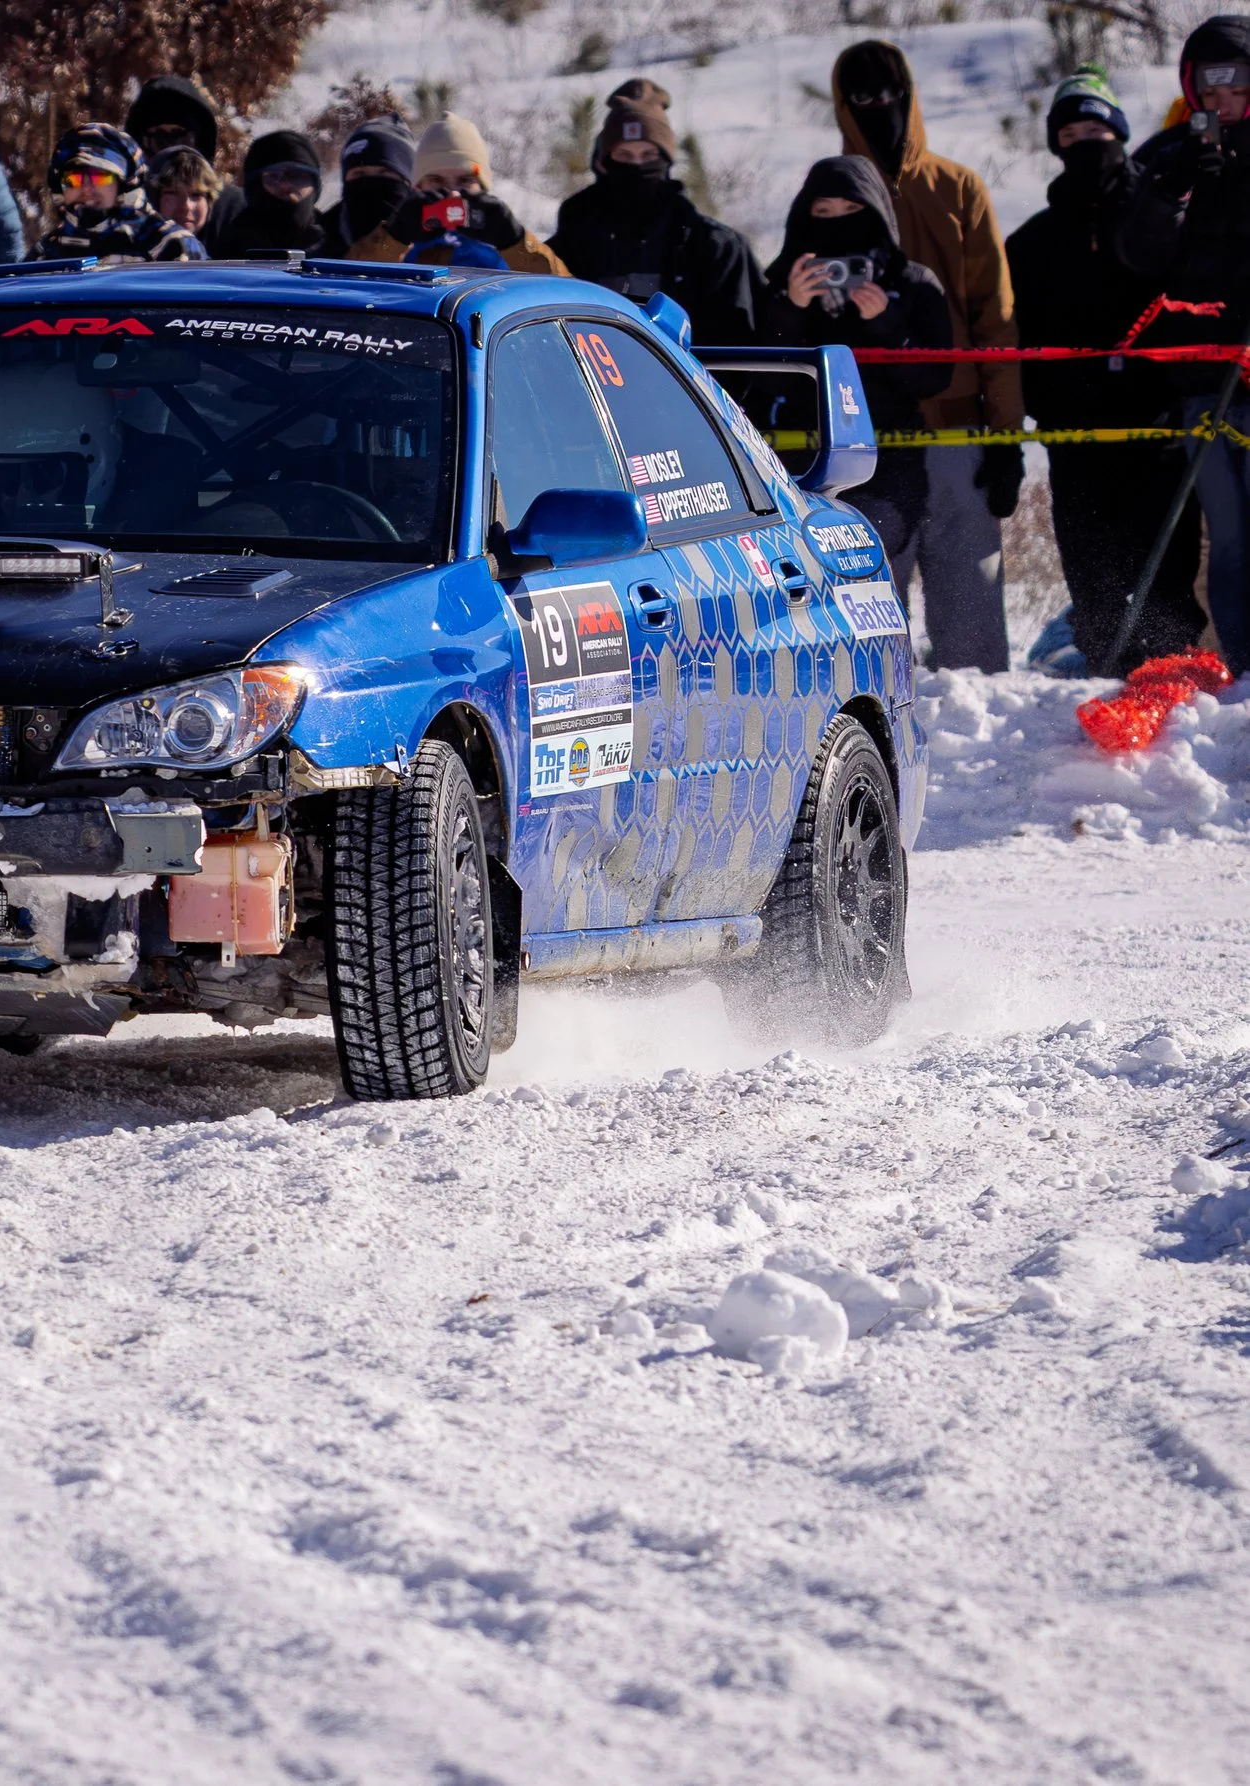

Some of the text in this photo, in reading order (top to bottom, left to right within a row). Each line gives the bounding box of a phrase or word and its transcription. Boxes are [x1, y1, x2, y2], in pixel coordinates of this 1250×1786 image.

[0, 317, 155, 337] ARA
[165, 318, 413, 351] AMERICAN RALLY
[180, 329, 381, 355] ASSOCIATION
[576, 333, 624, 387] 19
[643, 450, 685, 484] MOSLEY
[657, 482, 732, 522] OPPERTHAUSER
[807, 523, 876, 553] SPRINGLINE
[837, 553, 874, 571] EXCAVATING
[577, 602, 623, 636] ARA
[841, 594, 902, 631] Baxter
[532, 605, 568, 668] 19
[582, 636, 623, 651] AMERICAN RALLY
[538, 697, 553, 711] SNO
[553, 693, 575, 708] DRIFT
